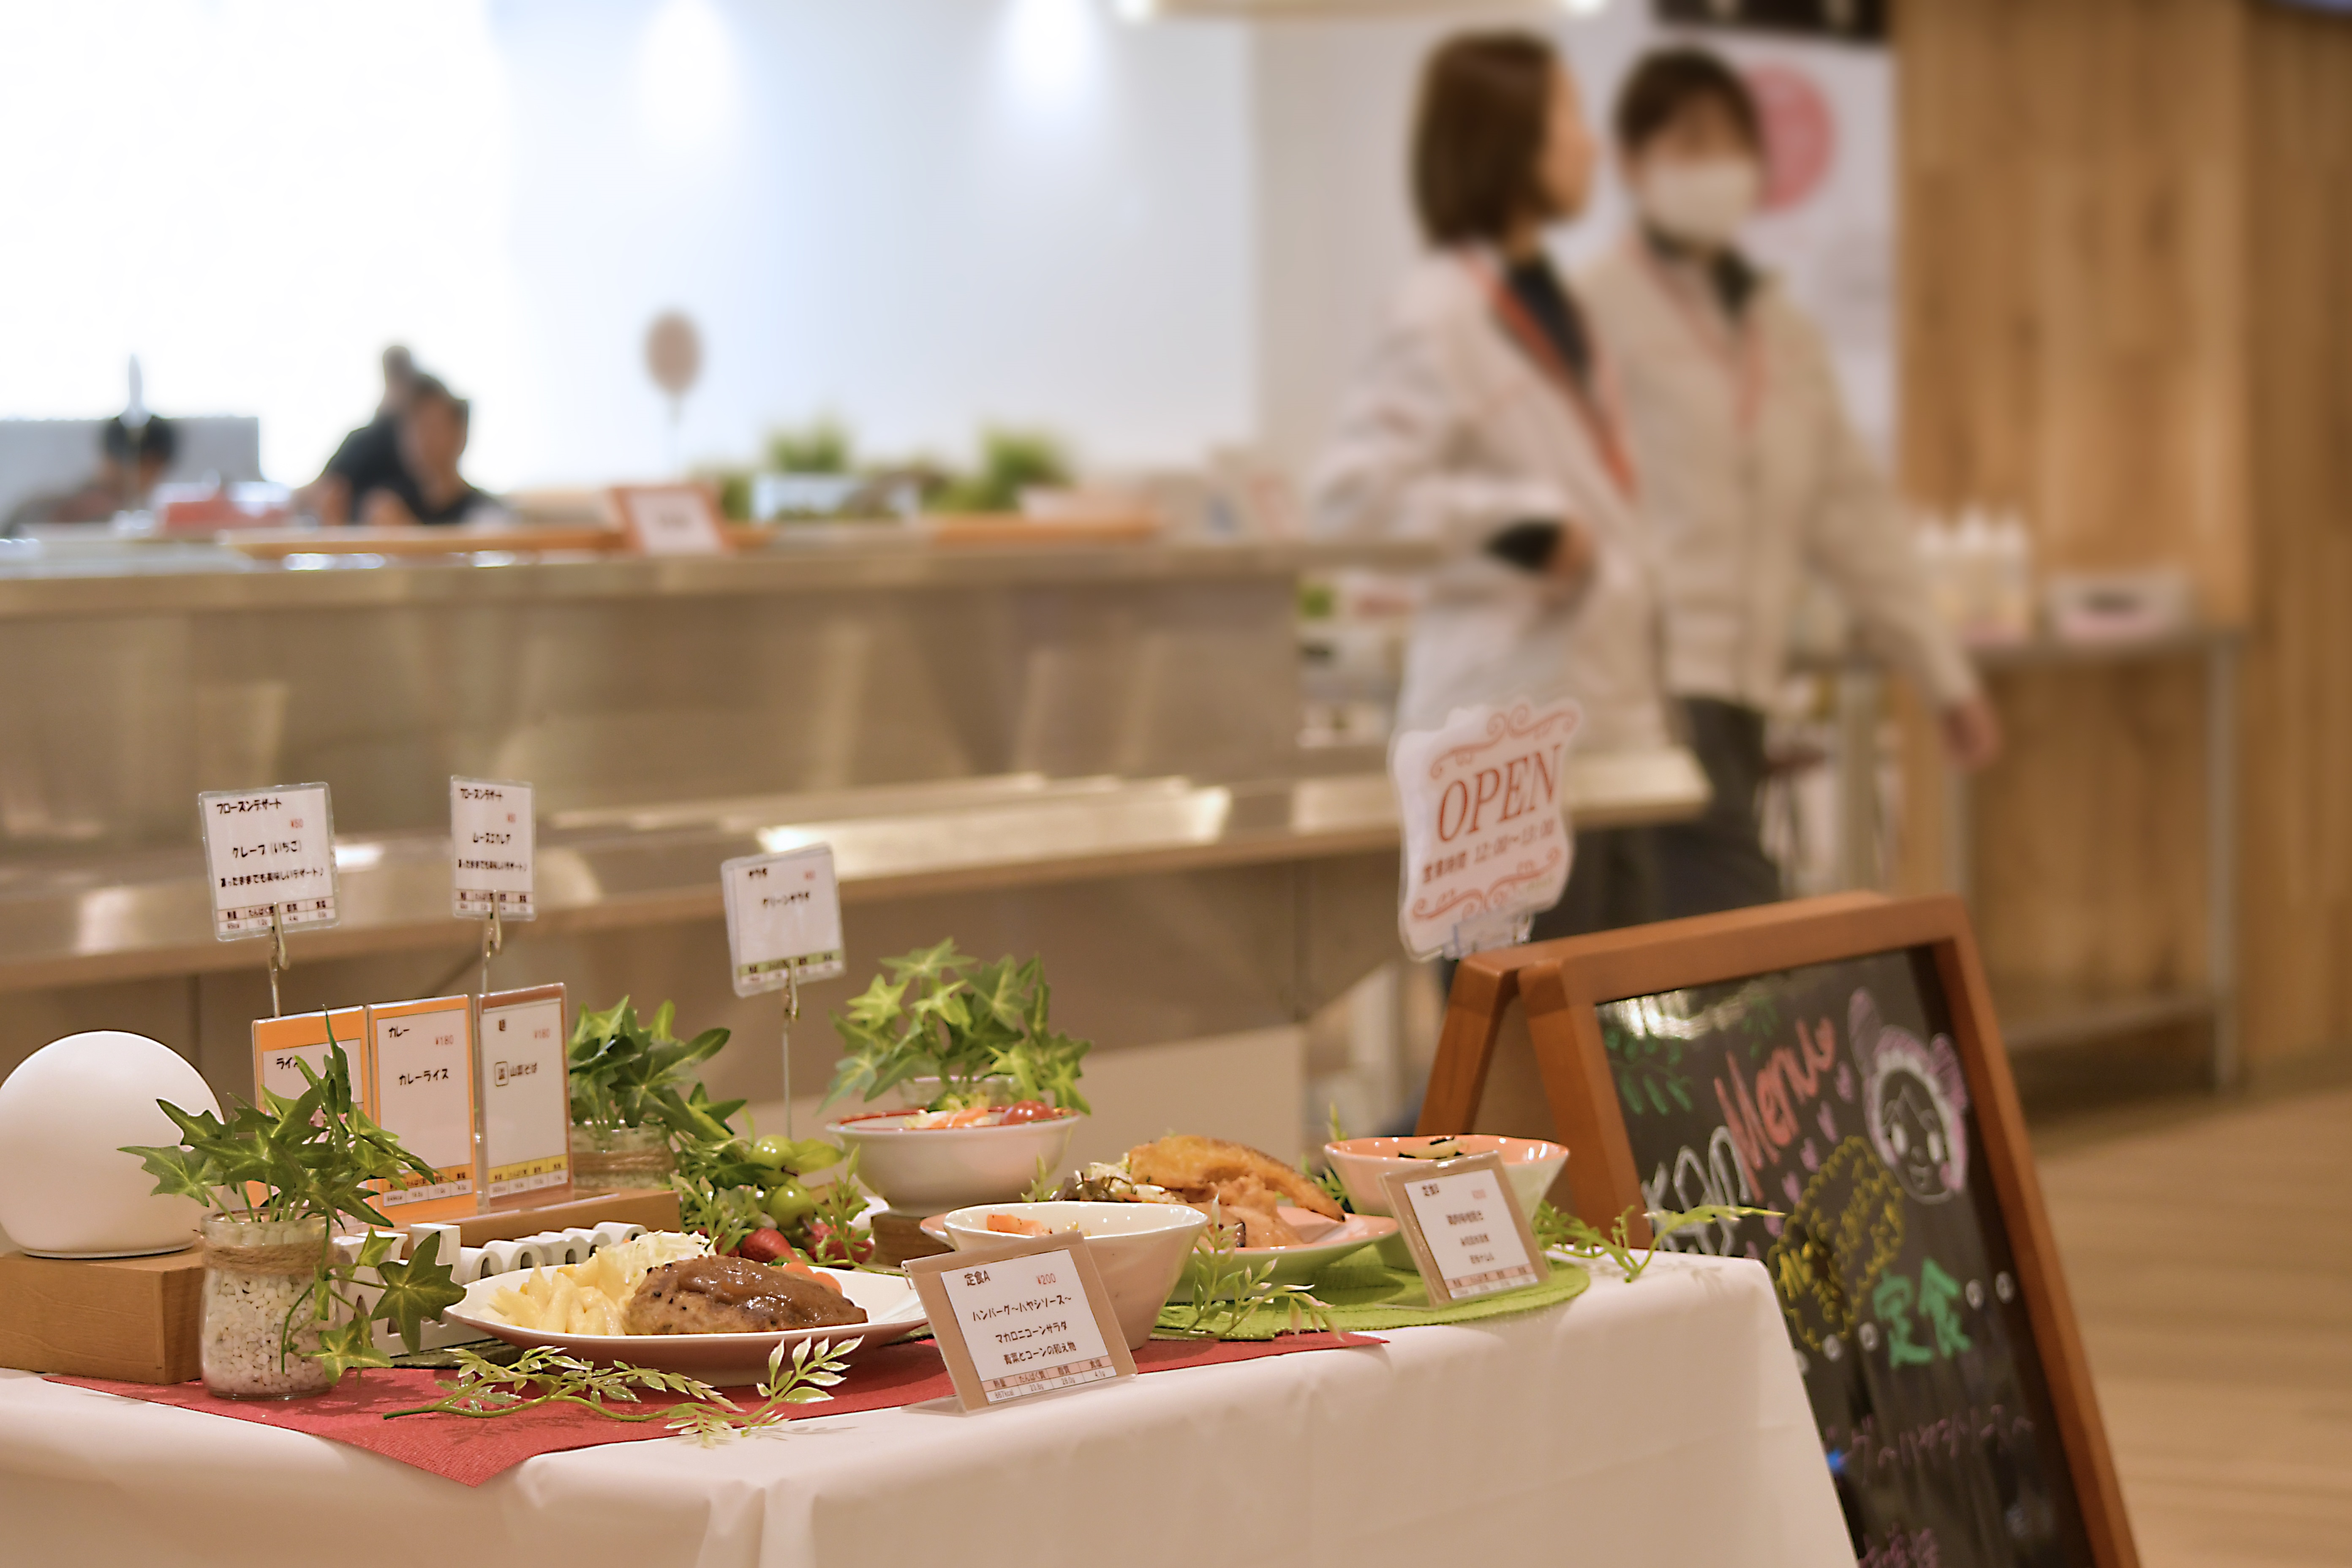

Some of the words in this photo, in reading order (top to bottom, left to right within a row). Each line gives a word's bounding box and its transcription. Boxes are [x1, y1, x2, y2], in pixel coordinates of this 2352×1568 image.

[1439, 744, 1560, 842] OPEN
[389, 1026, 410, 1038] カレー
[436, 1035, 454, 1045] ¥180
[399, 1068, 449, 1086] カレーライス
[1713, 1017, 1836, 1202] Menu
[964, 1270, 991, 1286] 定食A
[1036, 1273, 1056, 1285] ¥200
[1872, 1257, 1972, 1370] 定食
[996, 1321, 1067, 1344] マカロニコーンサラダ
